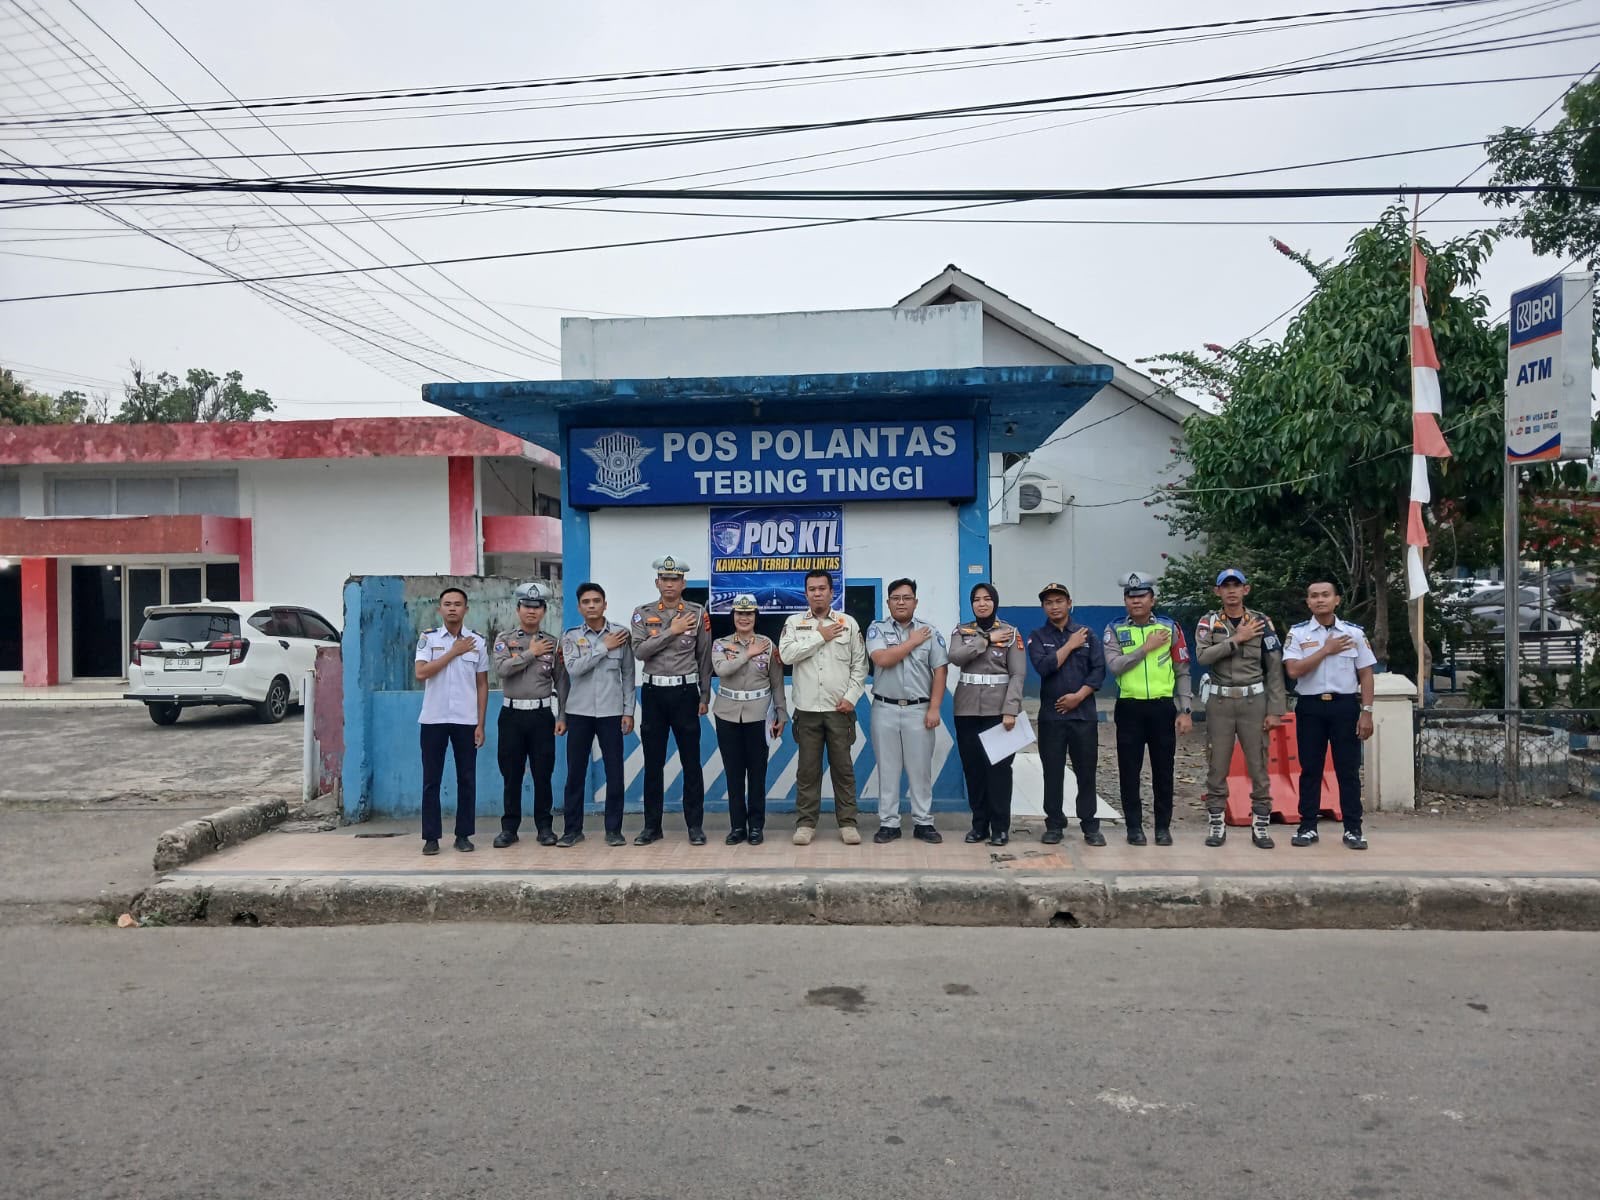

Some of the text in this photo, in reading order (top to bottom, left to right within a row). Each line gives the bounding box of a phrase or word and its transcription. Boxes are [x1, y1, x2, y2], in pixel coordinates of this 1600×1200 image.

[1532, 292, 1556, 326] BRI
[1516, 357, 1552, 387] ATM
[663, 425, 956, 462] POS POLANTAS
[694, 466, 923, 495] TEBING TINGGI
[743, 520, 840, 555] POS KTL
[715, 559, 759, 572] KAWASAN
[791, 557, 811, 570] LALU
[812, 557, 840, 570] LINTAS
